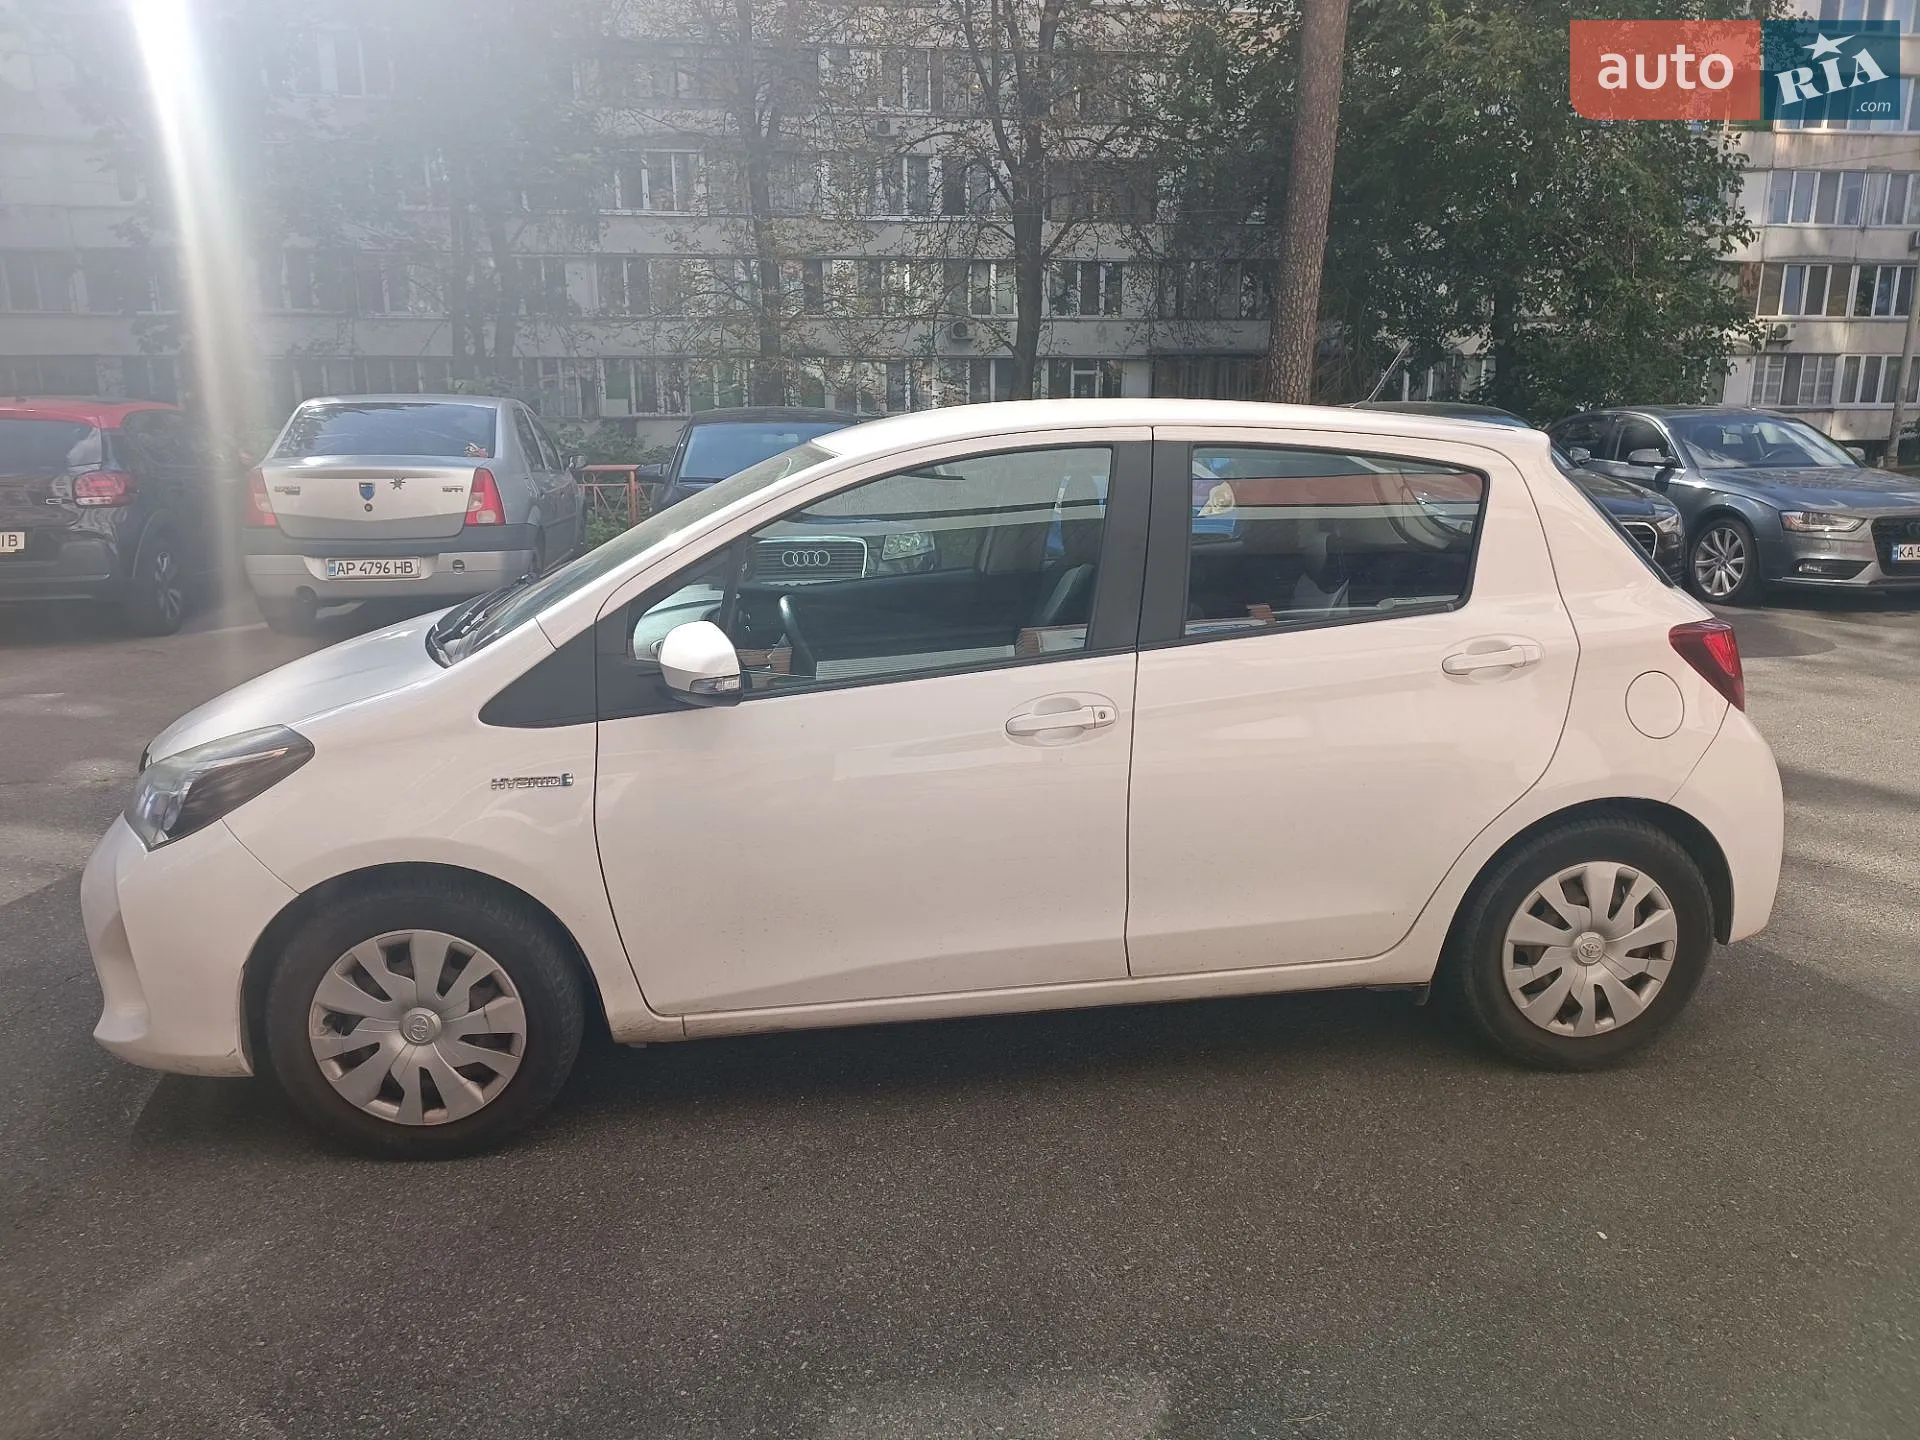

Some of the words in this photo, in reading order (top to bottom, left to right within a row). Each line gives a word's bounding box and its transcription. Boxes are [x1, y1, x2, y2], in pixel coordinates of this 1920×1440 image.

[1899, 546, 1914, 558] KA
[336, 561, 356, 575] AP
[359, 561, 391, 575] 4796
[394, 560, 414, 574] HB
